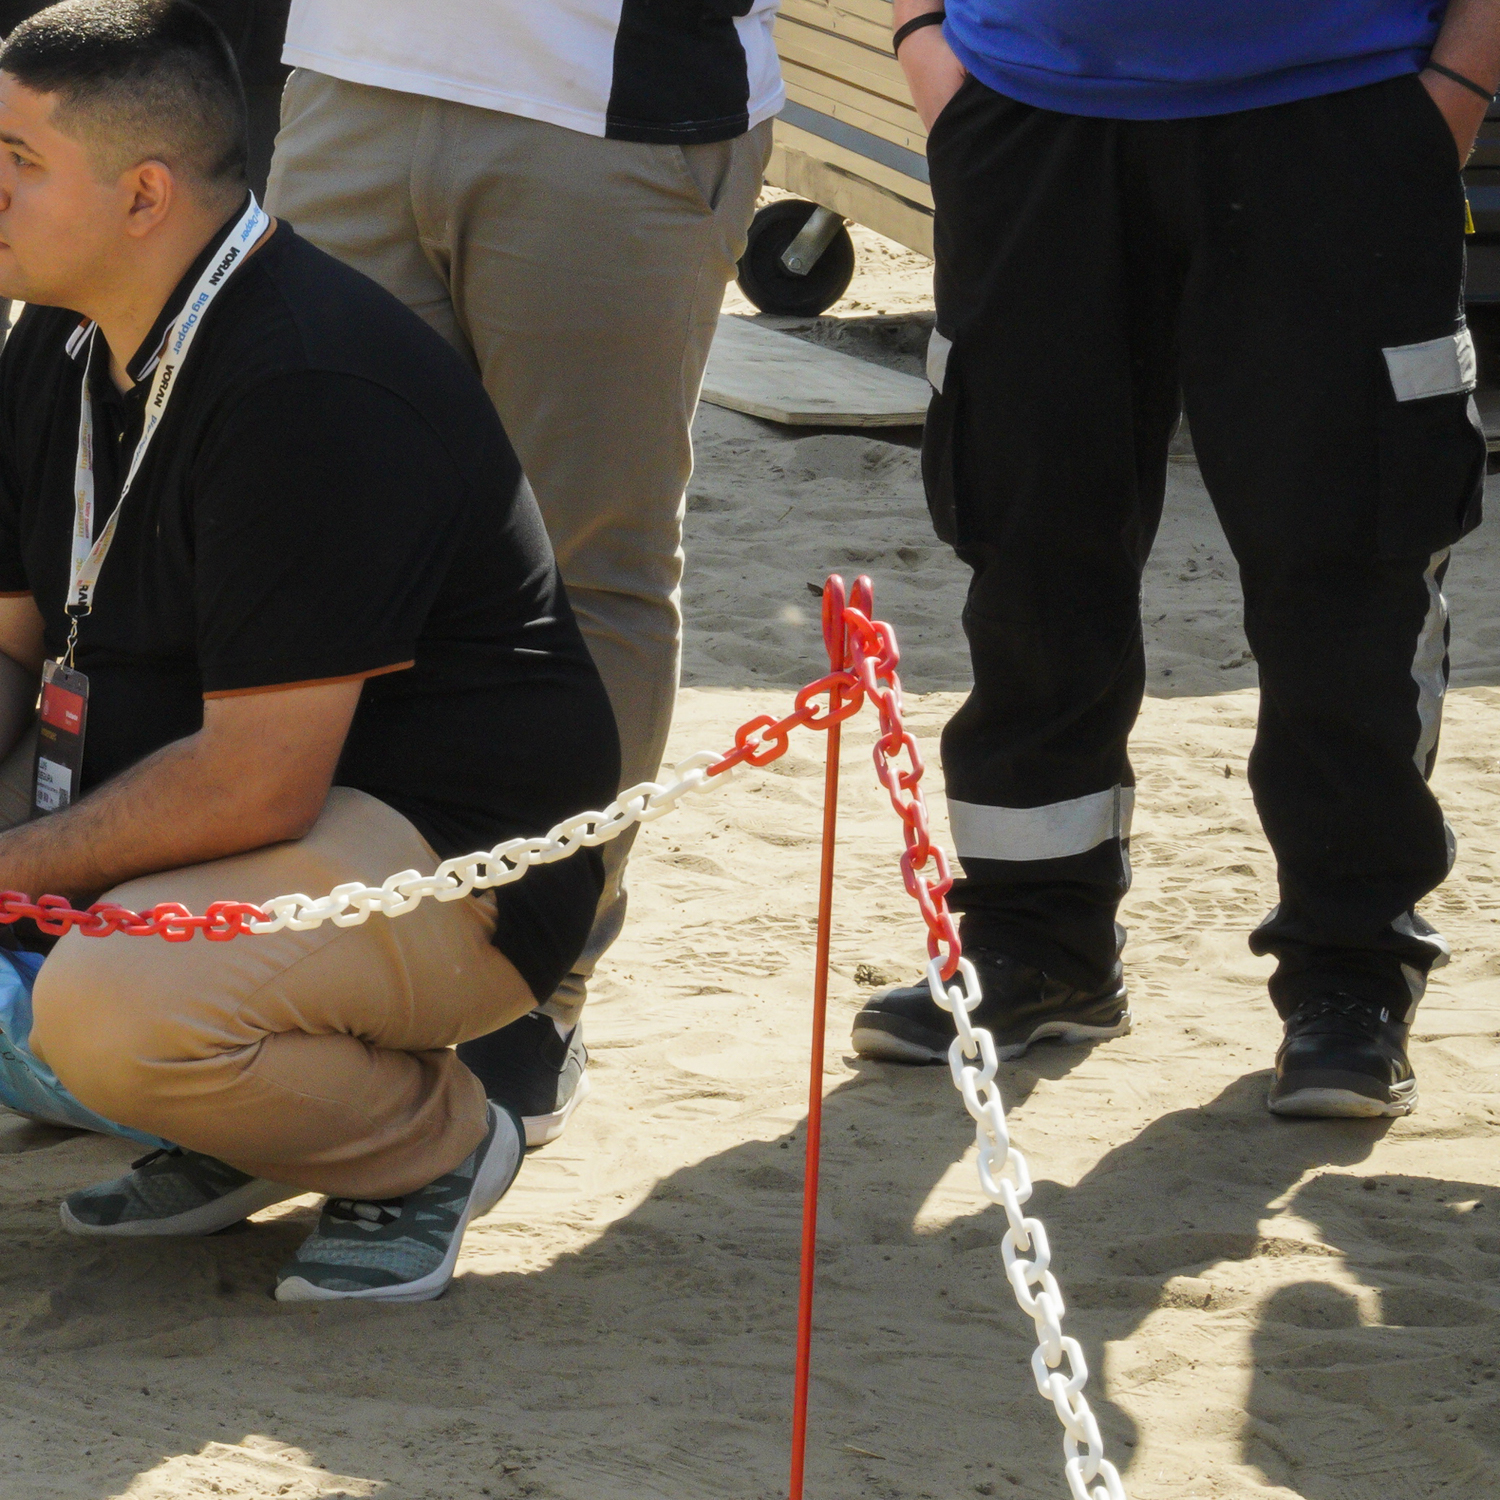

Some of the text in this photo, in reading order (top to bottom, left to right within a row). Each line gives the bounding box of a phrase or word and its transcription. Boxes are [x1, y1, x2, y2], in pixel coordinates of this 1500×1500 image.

[208, 246, 241, 286] VORAN
[173, 291, 210, 355] Big Dipper
[153, 363, 175, 408] VORAN
[77, 489, 87, 539] intersec
